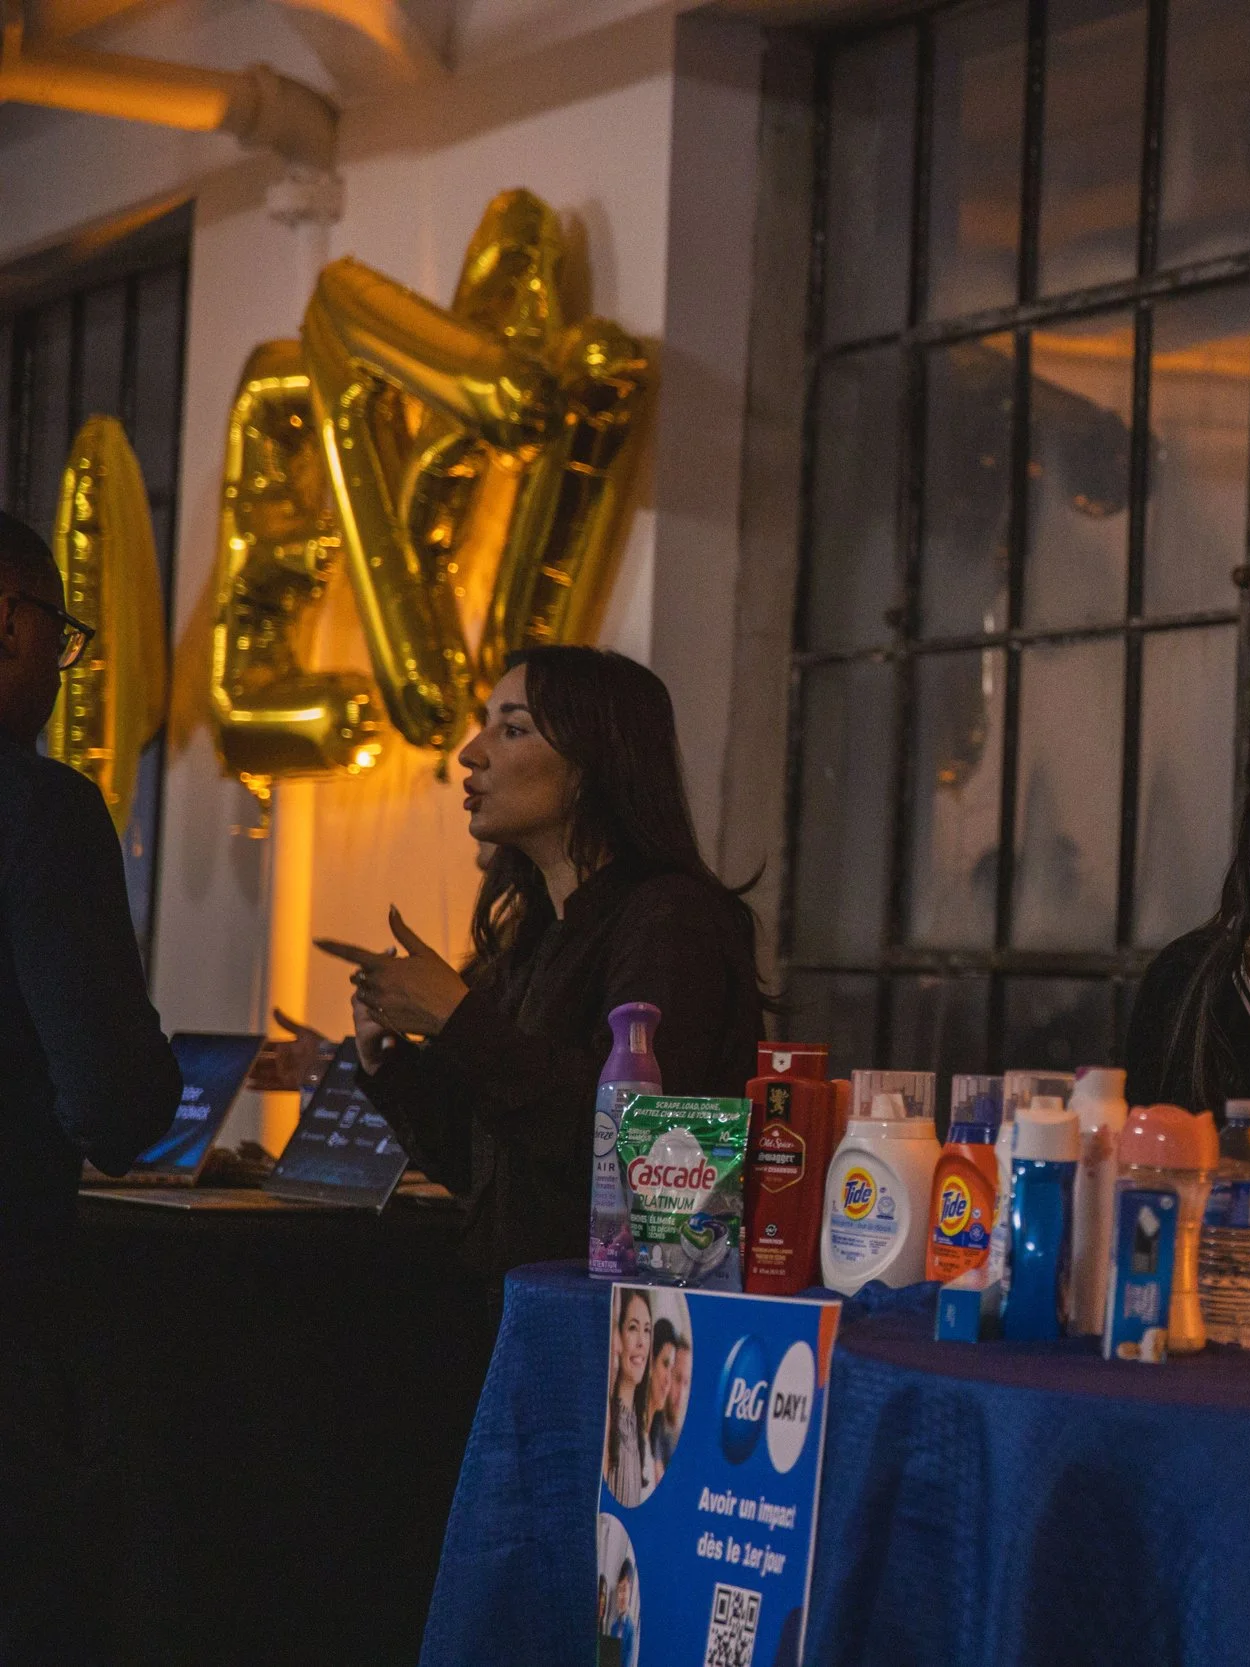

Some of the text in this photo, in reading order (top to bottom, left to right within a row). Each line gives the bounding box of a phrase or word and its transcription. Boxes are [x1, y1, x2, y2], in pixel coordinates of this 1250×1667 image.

[597, 1162, 615, 1171] AIR
[627, 1158, 716, 1191] Cascade
[638, 1194, 694, 1210] PLATINUM
[844, 1180, 872, 1209] Tide
[941, 1190, 967, 1222] Tide
[725, 1378, 768, 1421] P&G
[698, 1486, 738, 1516] Avoir
[738, 1498, 757, 1520] un
[697, 1531, 724, 1560] dès
[726, 1536, 741, 1564] le
[761, 1544, 786, 1577] jour
